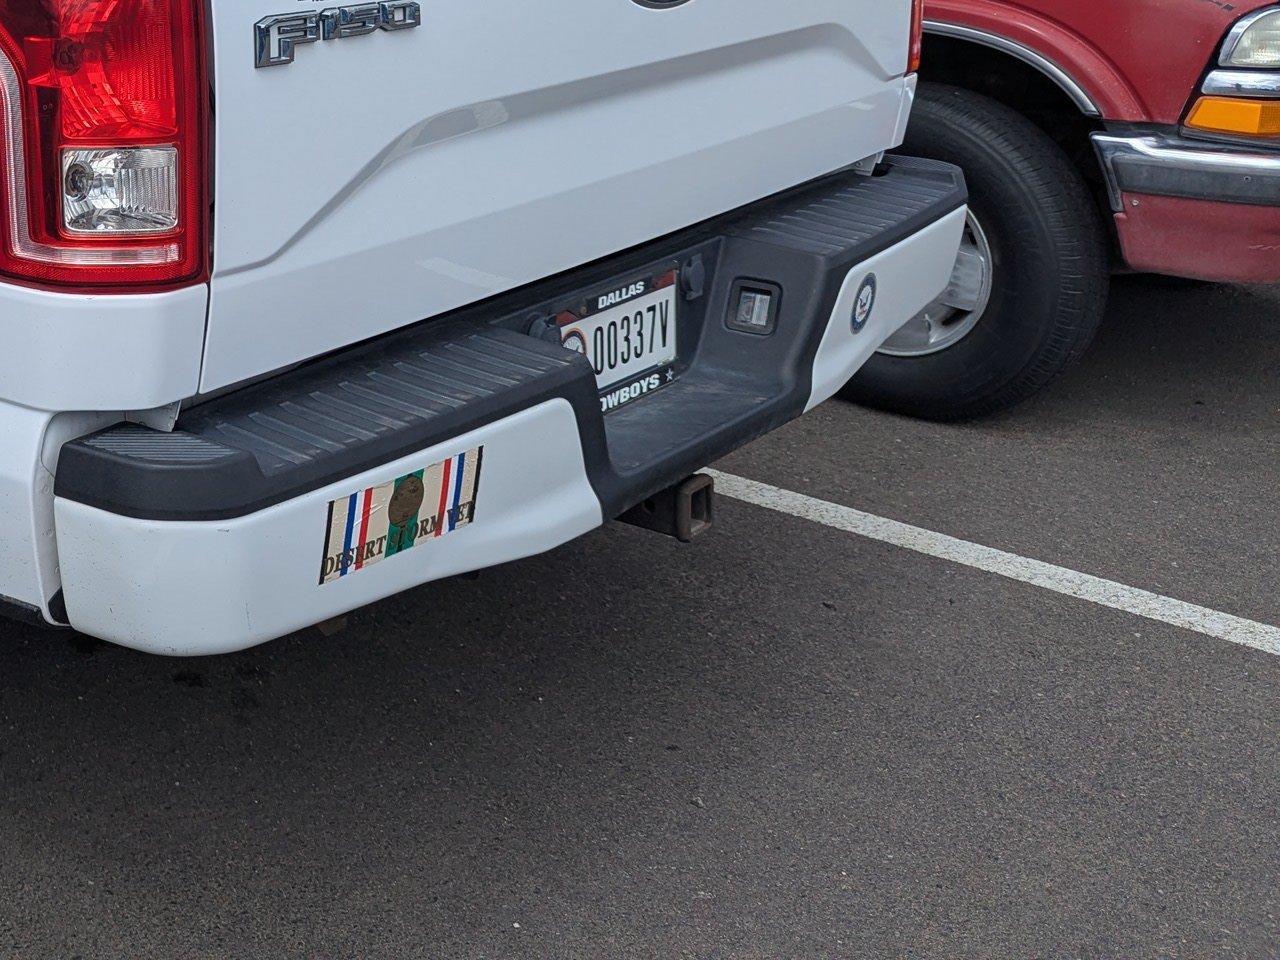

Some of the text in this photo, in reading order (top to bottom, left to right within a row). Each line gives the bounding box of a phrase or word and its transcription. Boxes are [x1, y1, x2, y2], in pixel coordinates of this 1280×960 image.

[597, 281, 645, 309] DALLAS
[593, 299, 670, 375] 00337V
[323, 534, 387, 578] DESERT
